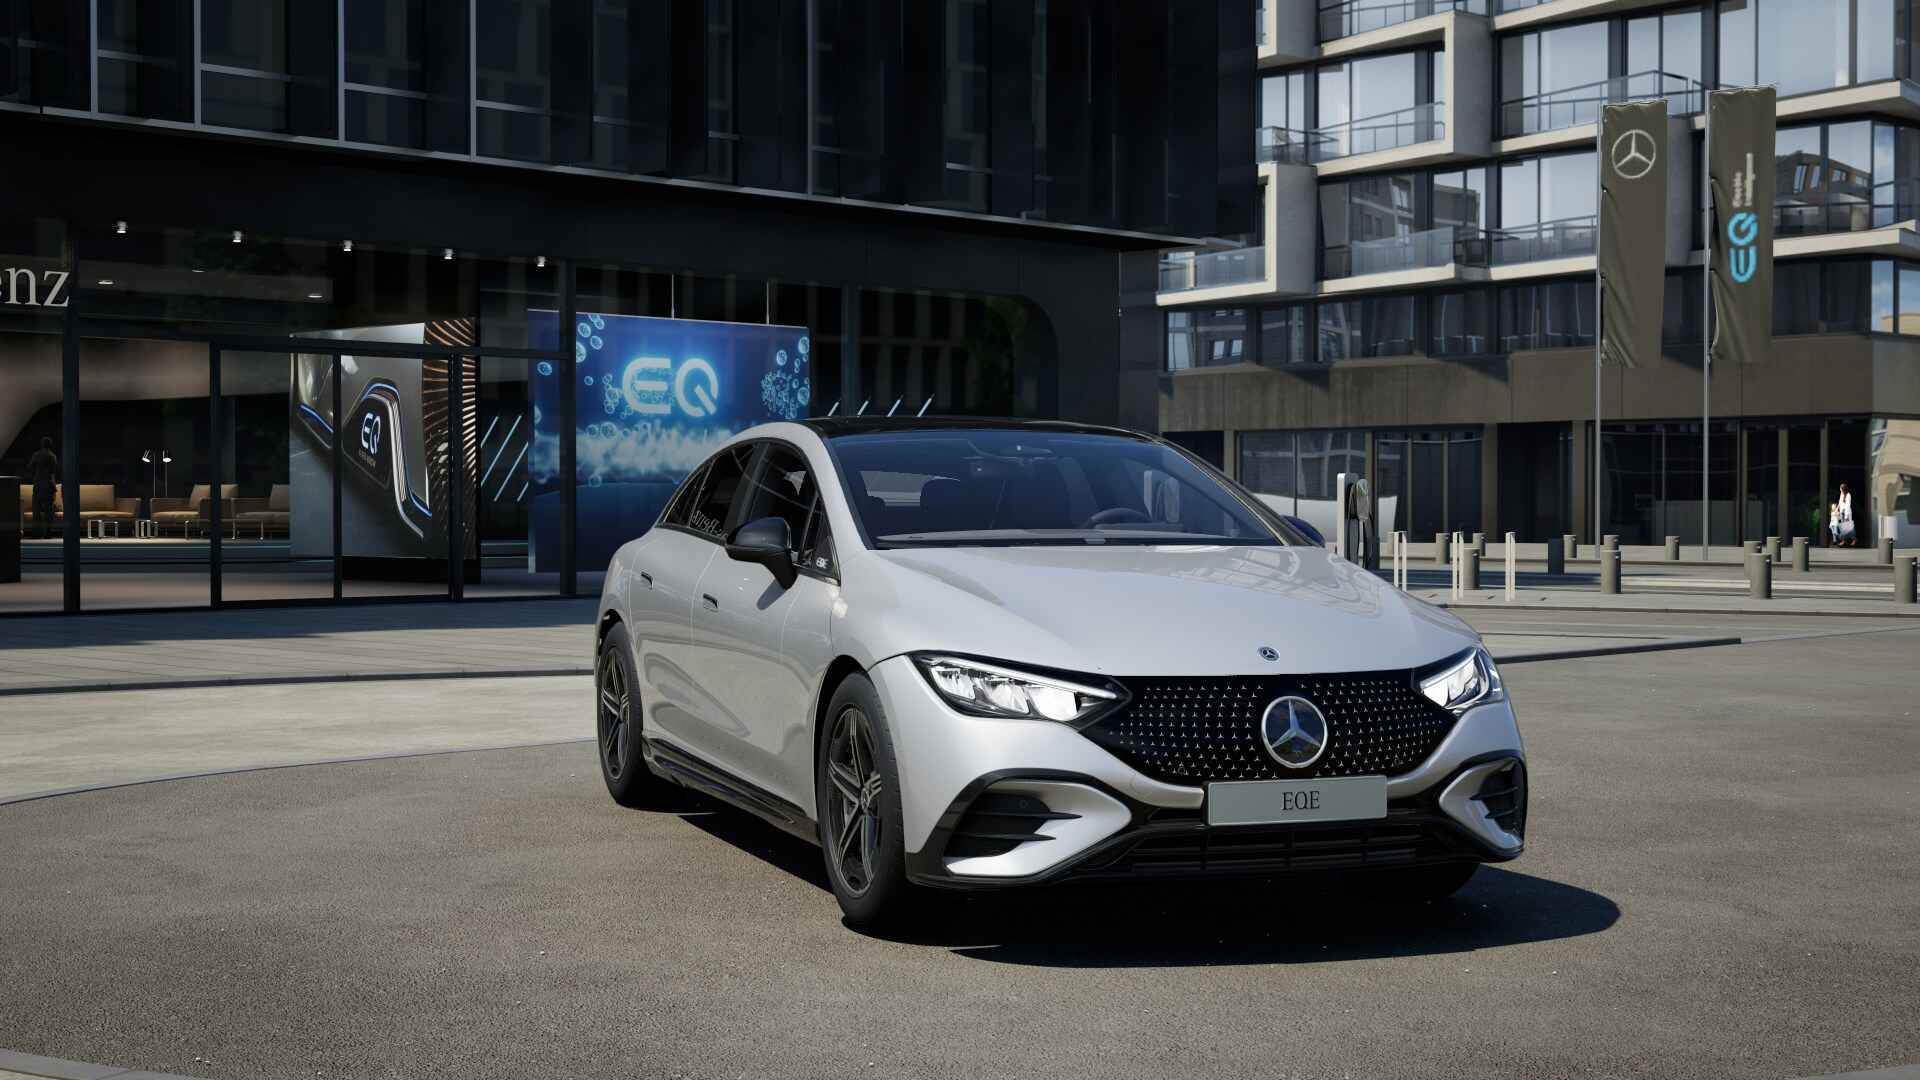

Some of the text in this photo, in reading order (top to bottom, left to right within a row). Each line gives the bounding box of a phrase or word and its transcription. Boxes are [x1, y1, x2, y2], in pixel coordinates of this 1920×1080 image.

[1727, 212, 1758, 283] EQ
[0, 267, 70, 307] nz
[622, 357, 719, 417] EQ
[361, 412, 381, 455] EQ
[1281, 790, 1321, 811] EQE
